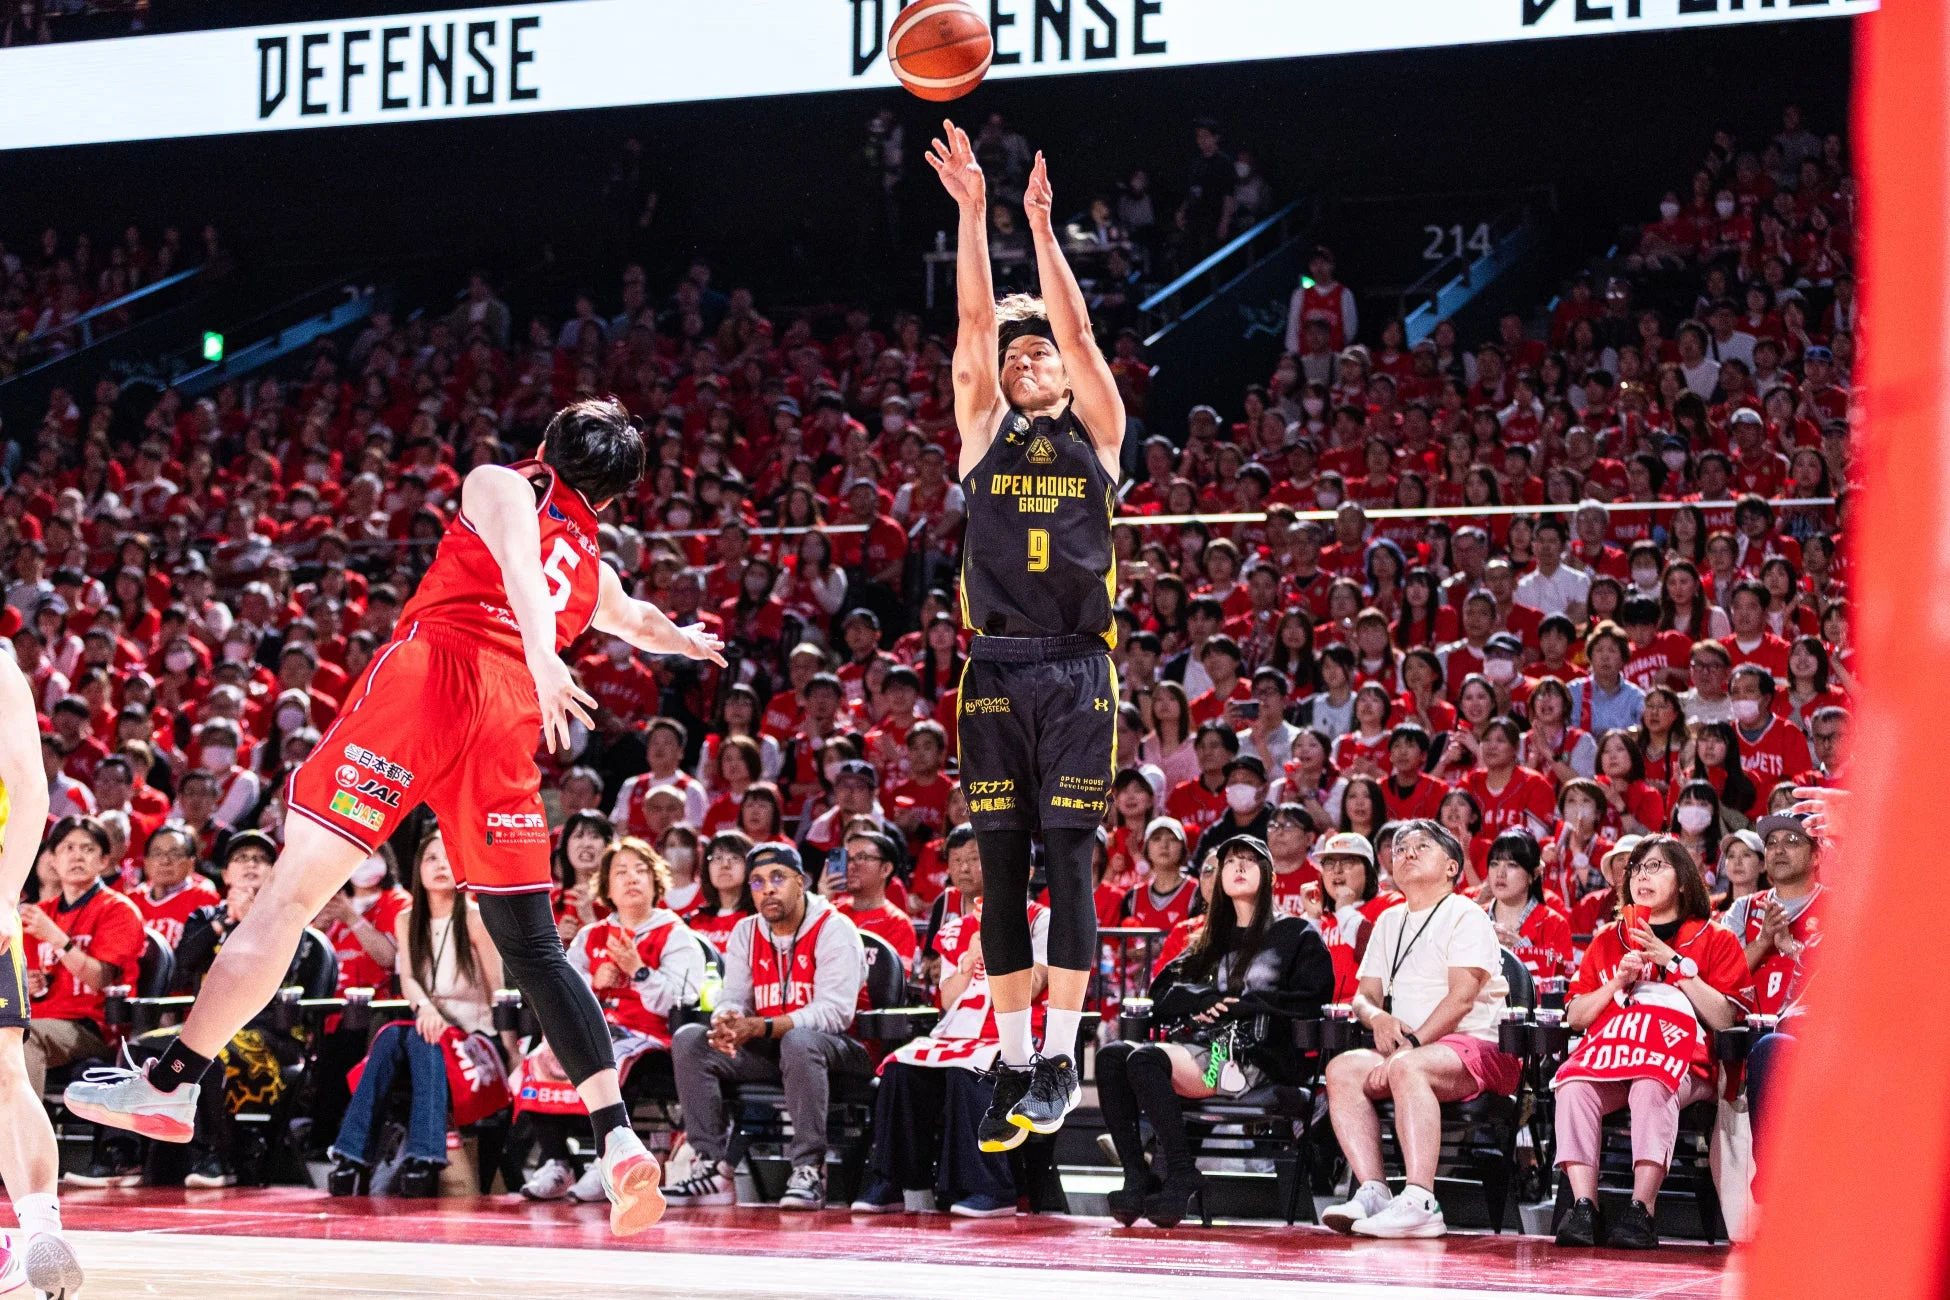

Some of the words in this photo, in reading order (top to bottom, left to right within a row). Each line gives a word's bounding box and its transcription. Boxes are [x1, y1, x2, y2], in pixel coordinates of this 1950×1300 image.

[851, 0, 1167, 76] DENSE
[257, 15, 541, 120] DEFENSE
[1423, 223, 1491, 258] 214
[991, 475, 1032, 495] OPEN
[1037, 477, 1087, 498] HOUSE
[1018, 498, 1059, 513] GROUP
[1027, 528, 1050, 572] 9
[544, 537, 580, 612] 5
[975, 697, 1010, 707] RYOMO
[981, 705, 1011, 714] SYSTEMS
[1060, 775, 1081, 784] OPEN
[357, 781, 400, 807] JAL
[352, 804, 386, 828] JAFS
